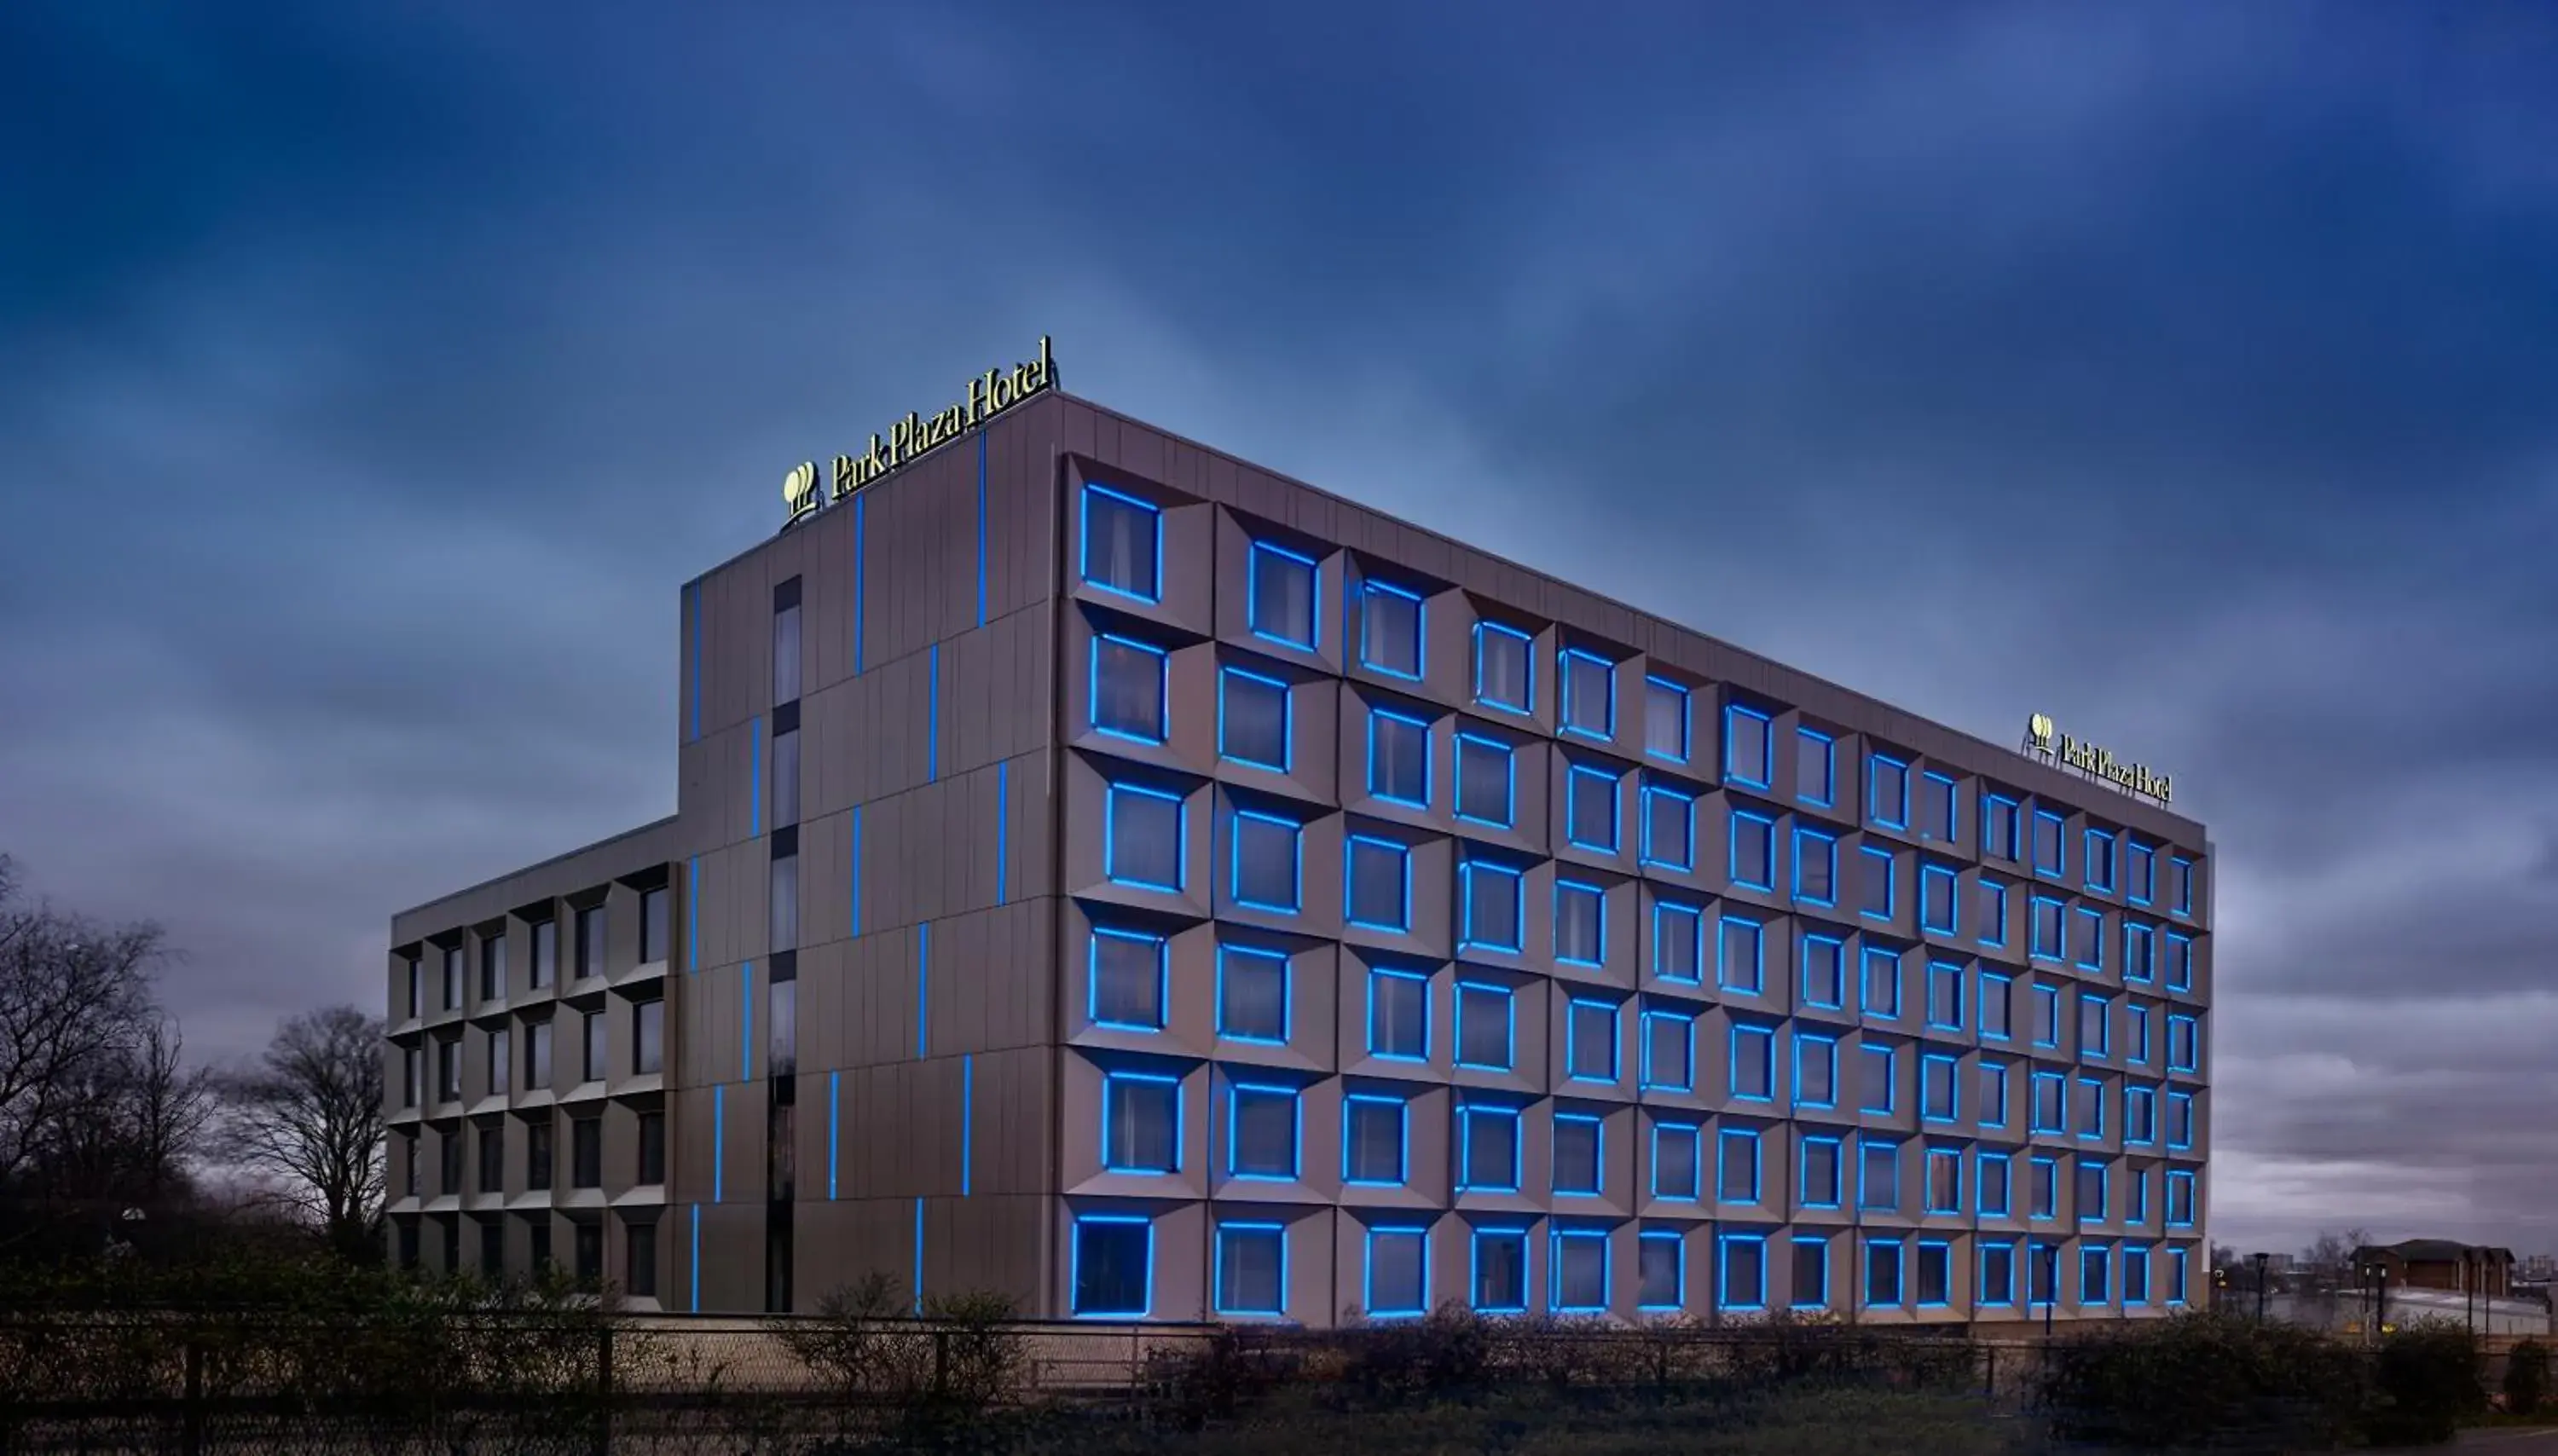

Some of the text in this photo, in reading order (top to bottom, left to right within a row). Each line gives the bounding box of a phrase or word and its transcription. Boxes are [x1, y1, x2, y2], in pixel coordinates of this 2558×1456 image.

[830, 334, 1050, 499] Park Plaza Hotel
[2062, 734, 2172, 801] Park Plaza Hotel
